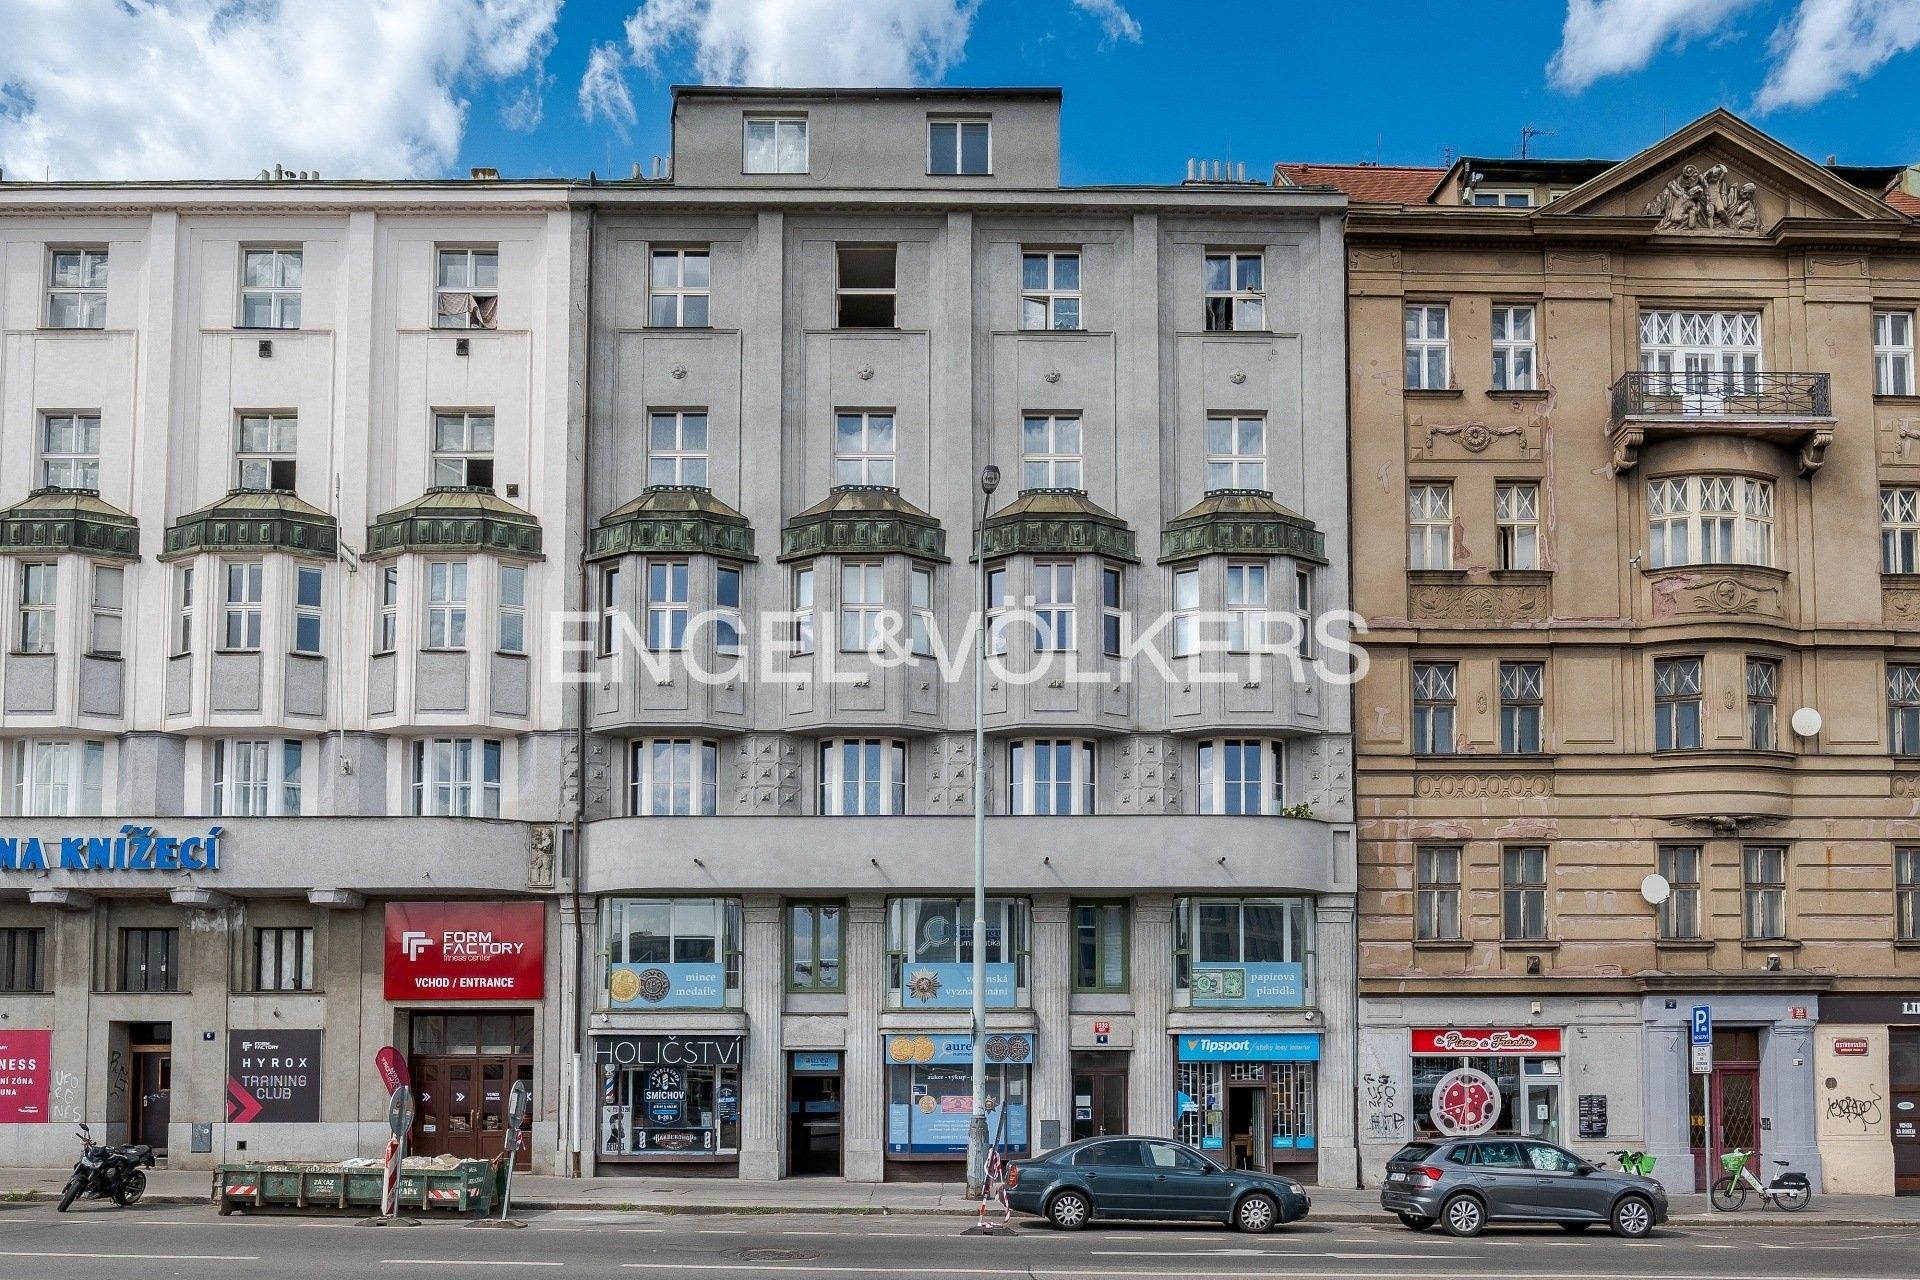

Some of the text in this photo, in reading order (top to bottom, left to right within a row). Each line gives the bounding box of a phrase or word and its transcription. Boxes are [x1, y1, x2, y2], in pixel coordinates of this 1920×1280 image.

[0, 824, 225, 871] NA KNÍŽECÍ
[443, 931, 492, 943] FORM
[443, 942, 524, 955] FACTORY
[443, 954, 467, 962] fitness
[415, 977, 450, 989] VCHOD
[459, 977, 515, 989] ENTRANCE
[685, 972, 717, 983] mince
[1251, 973, 1295, 984] papírová
[676, 987, 717, 997] medaile
[1256, 985, 1295, 997] platidla
[1695, 1010, 1707, 1033] P
[945, 1042, 974, 1051] aure
[1200, 1039, 1250, 1053] Tipsport
[1491, 1034, 1535, 1049] Frankie
[595, 1036, 741, 1064] HOLIČSTVÍ
[242, 1058, 307, 1068] HYROX
[11, 1077, 34, 1085] ZÓNA
[242, 1075, 307, 1087] TRAINING
[256, 1087, 291, 1100] CLUB
[646, 1089, 685, 1100] SMÍCHOV
